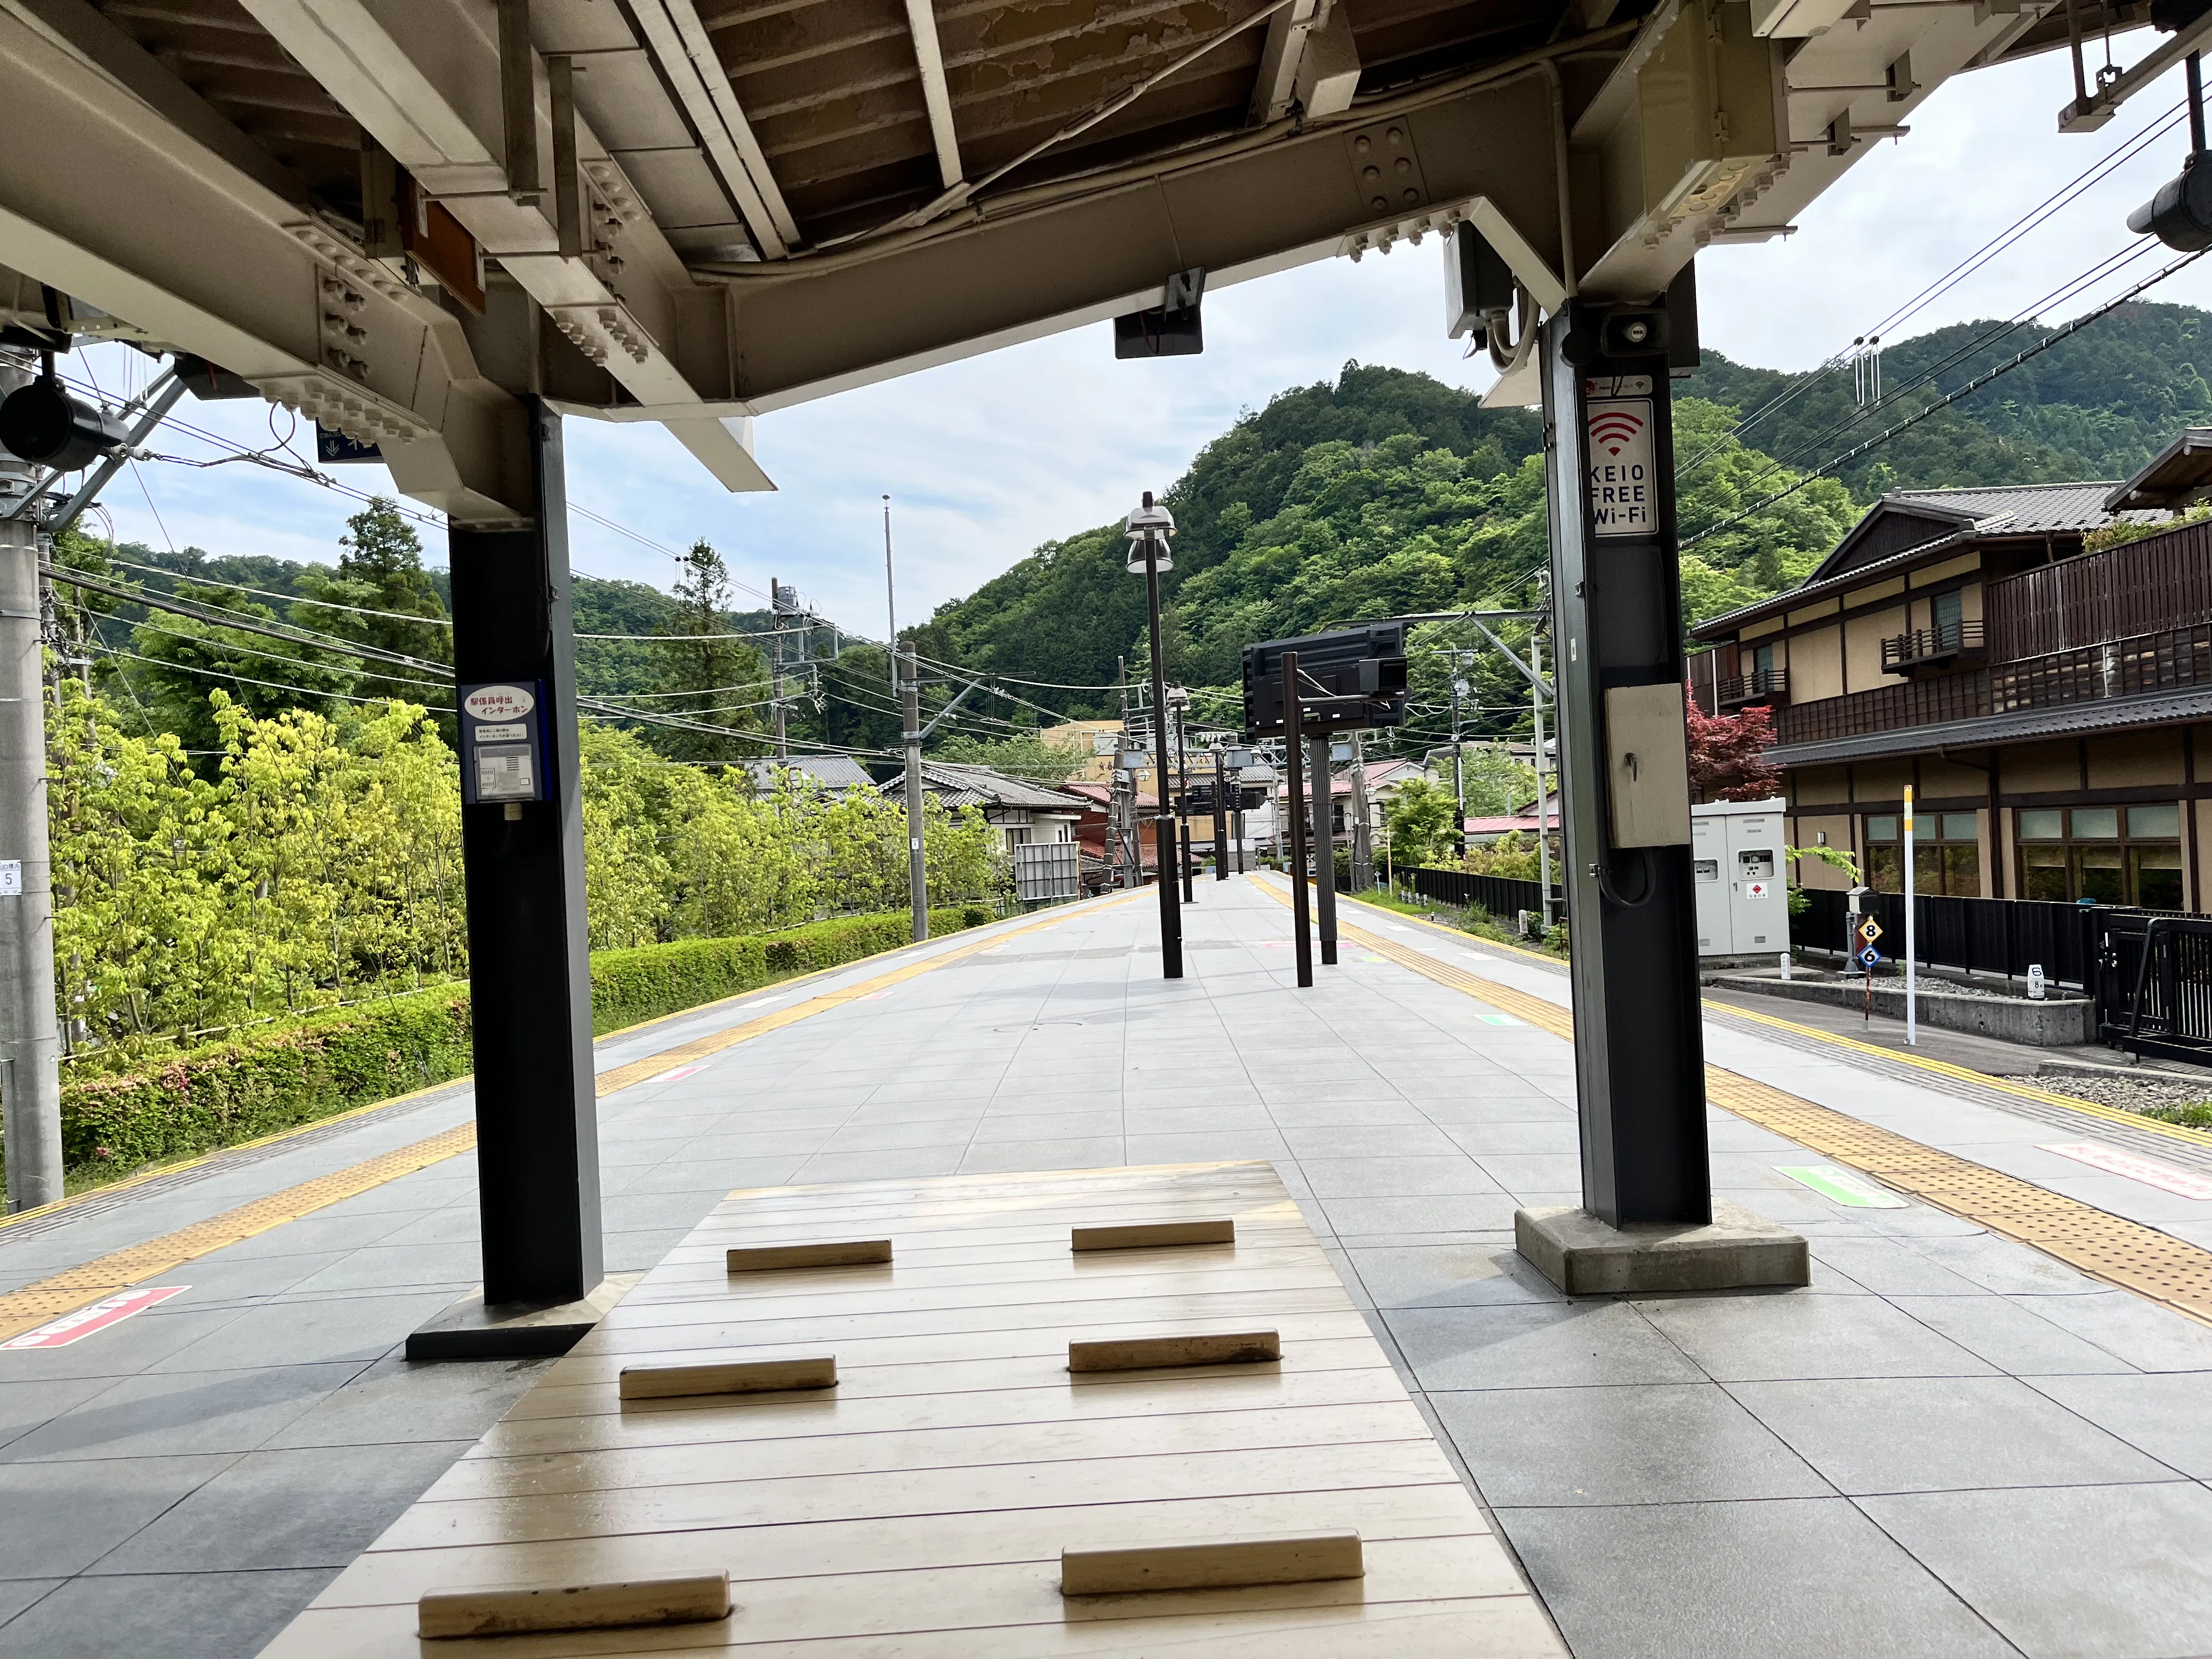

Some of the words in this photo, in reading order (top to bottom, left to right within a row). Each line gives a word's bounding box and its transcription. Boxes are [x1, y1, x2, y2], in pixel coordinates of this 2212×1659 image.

[1591, 465, 1644, 483] KEIO
[1592, 485, 1645, 504] FREE
[1594, 506, 1646, 525] Wi-Fi
[471, 696, 512, 706] 駅係員呼出
[482, 706, 528, 714] インターホン
[5, 873, 12, 885] 5
[1866, 925, 1876, 937] 8
[1864, 951, 1875, 962] 6
[2032, 968, 2042, 976] 6
